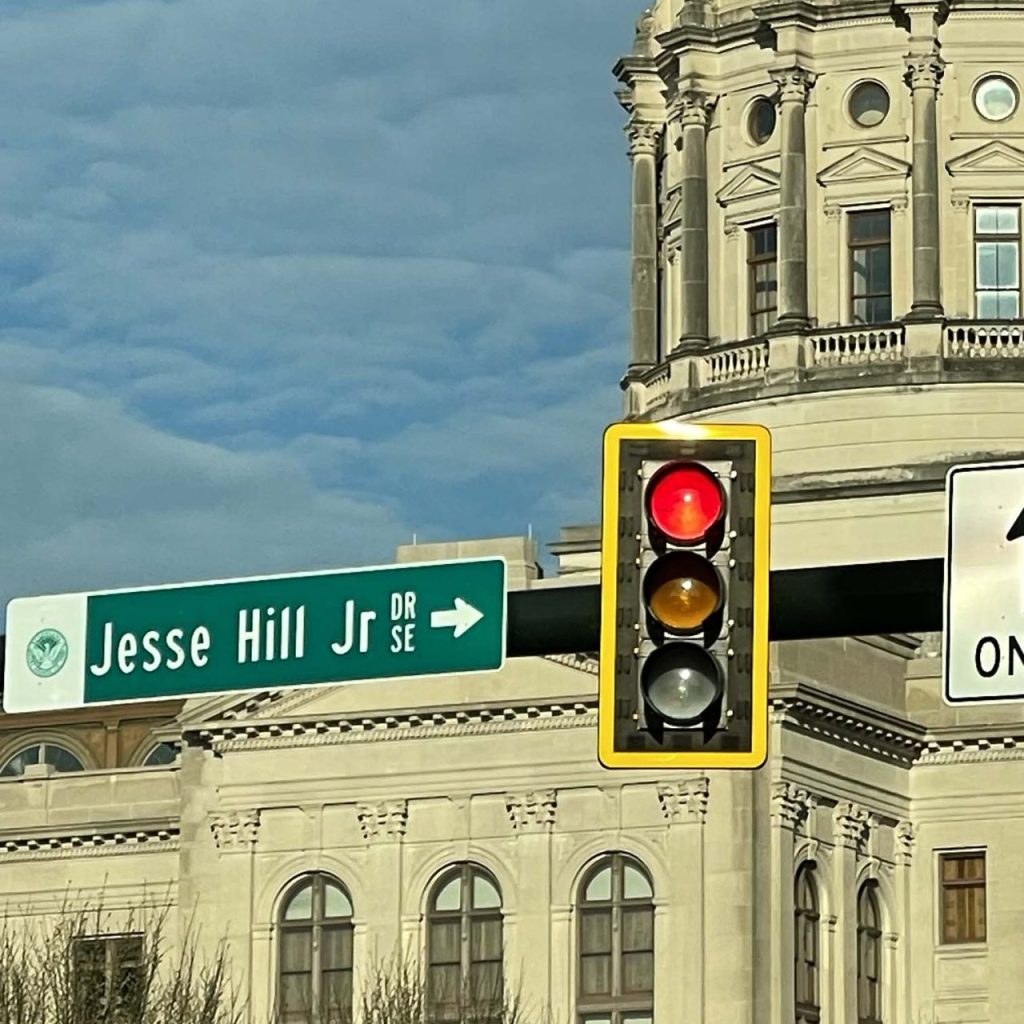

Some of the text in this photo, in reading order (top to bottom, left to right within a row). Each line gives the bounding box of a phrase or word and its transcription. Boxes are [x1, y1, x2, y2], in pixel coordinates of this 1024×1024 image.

[391, 591, 417, 621] DR
[90, 622, 211, 676] Jesse
[238, 605, 305, 663] Hill
[331, 600, 377, 655] Jr
[390, 624, 416, 653] SE
